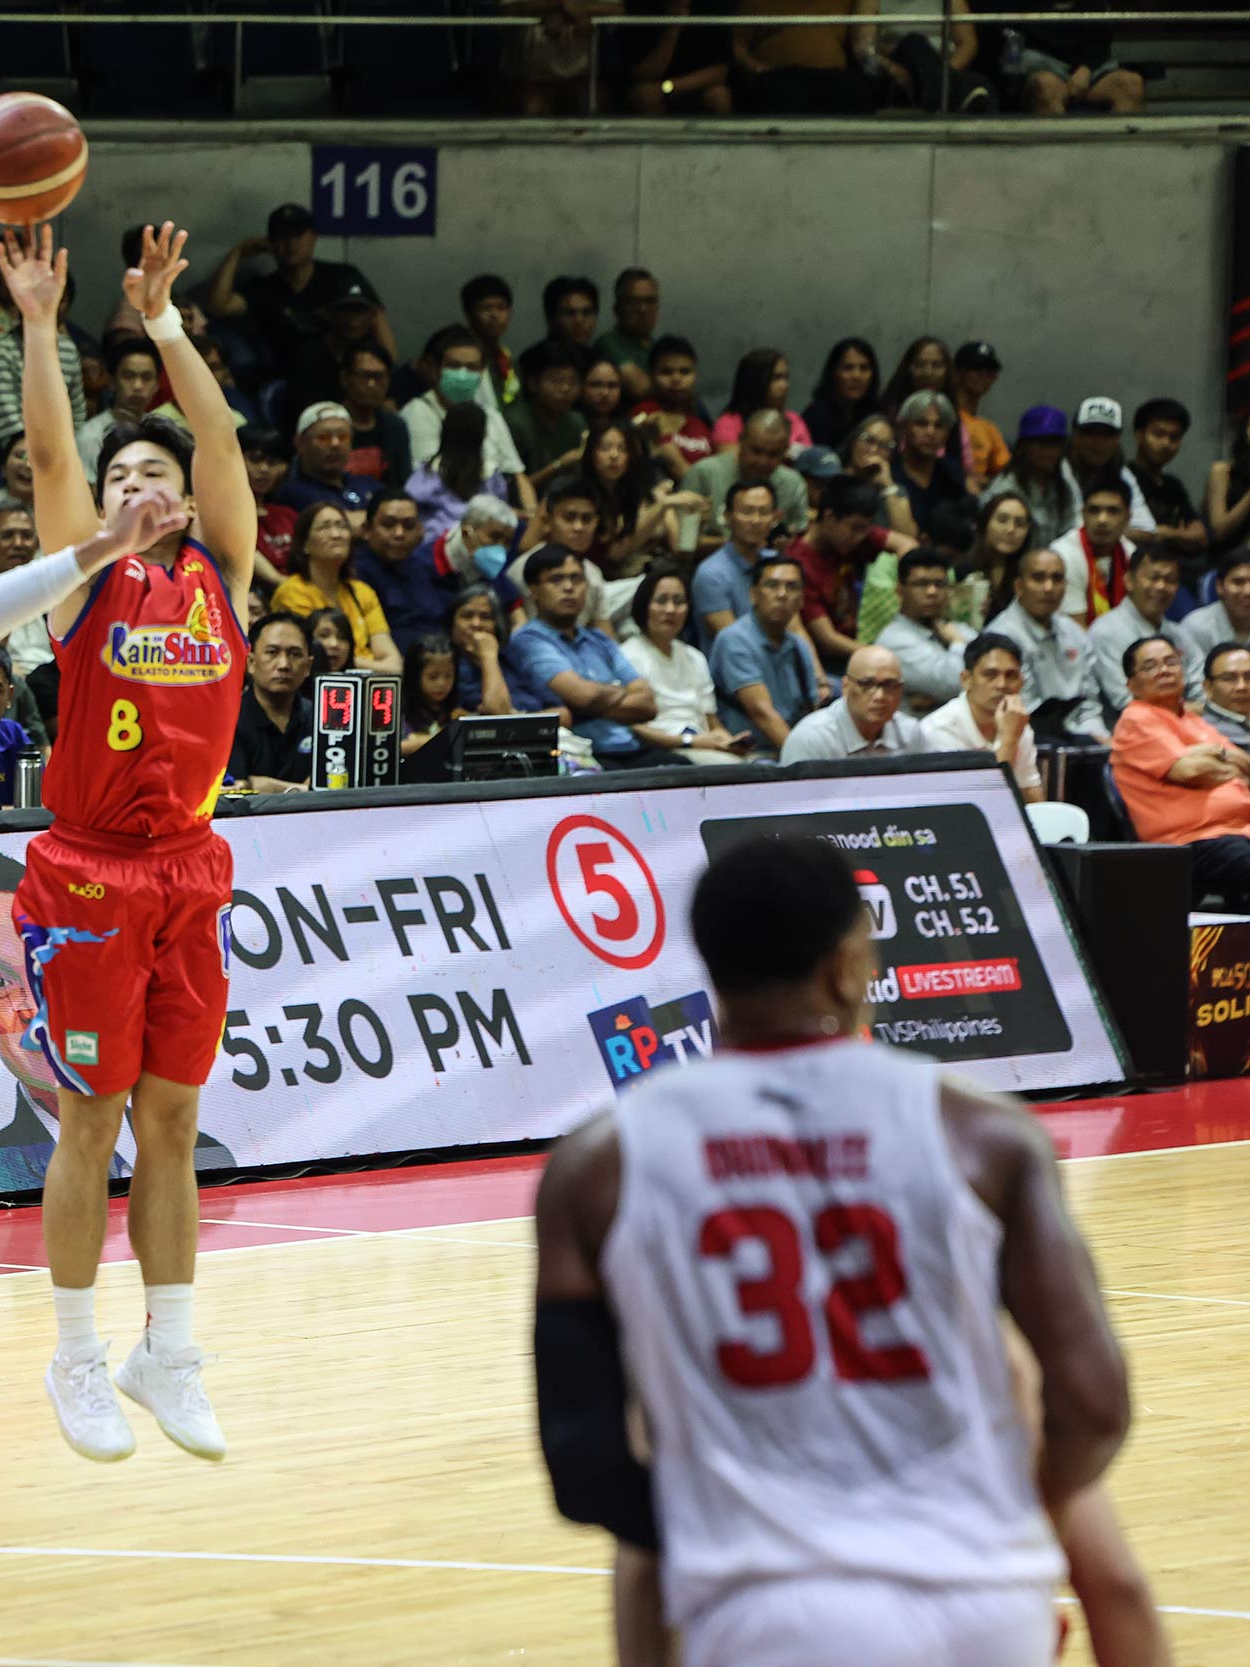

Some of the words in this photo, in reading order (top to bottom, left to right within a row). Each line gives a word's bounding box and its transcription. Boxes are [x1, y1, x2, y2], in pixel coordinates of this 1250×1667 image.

[320, 161, 430, 219] 116
[107, 698, 142, 752] 8
[372, 688, 393, 725] 4
[914, 828, 938, 846] sa
[575, 842, 640, 942] 5
[904, 875, 950, 904] CH.
[950, 872, 983, 900] 5.1
[229, 873, 513, 970] ON-FRI
[914, 909, 962, 939] CH.
[959, 906, 1000, 935] 5.2
[902, 960, 1016, 996] LIVESTREAM
[222, 998, 393, 1091] 5:30
[407, 988, 533, 1072] PM
[697, 1203, 933, 1388] 32
